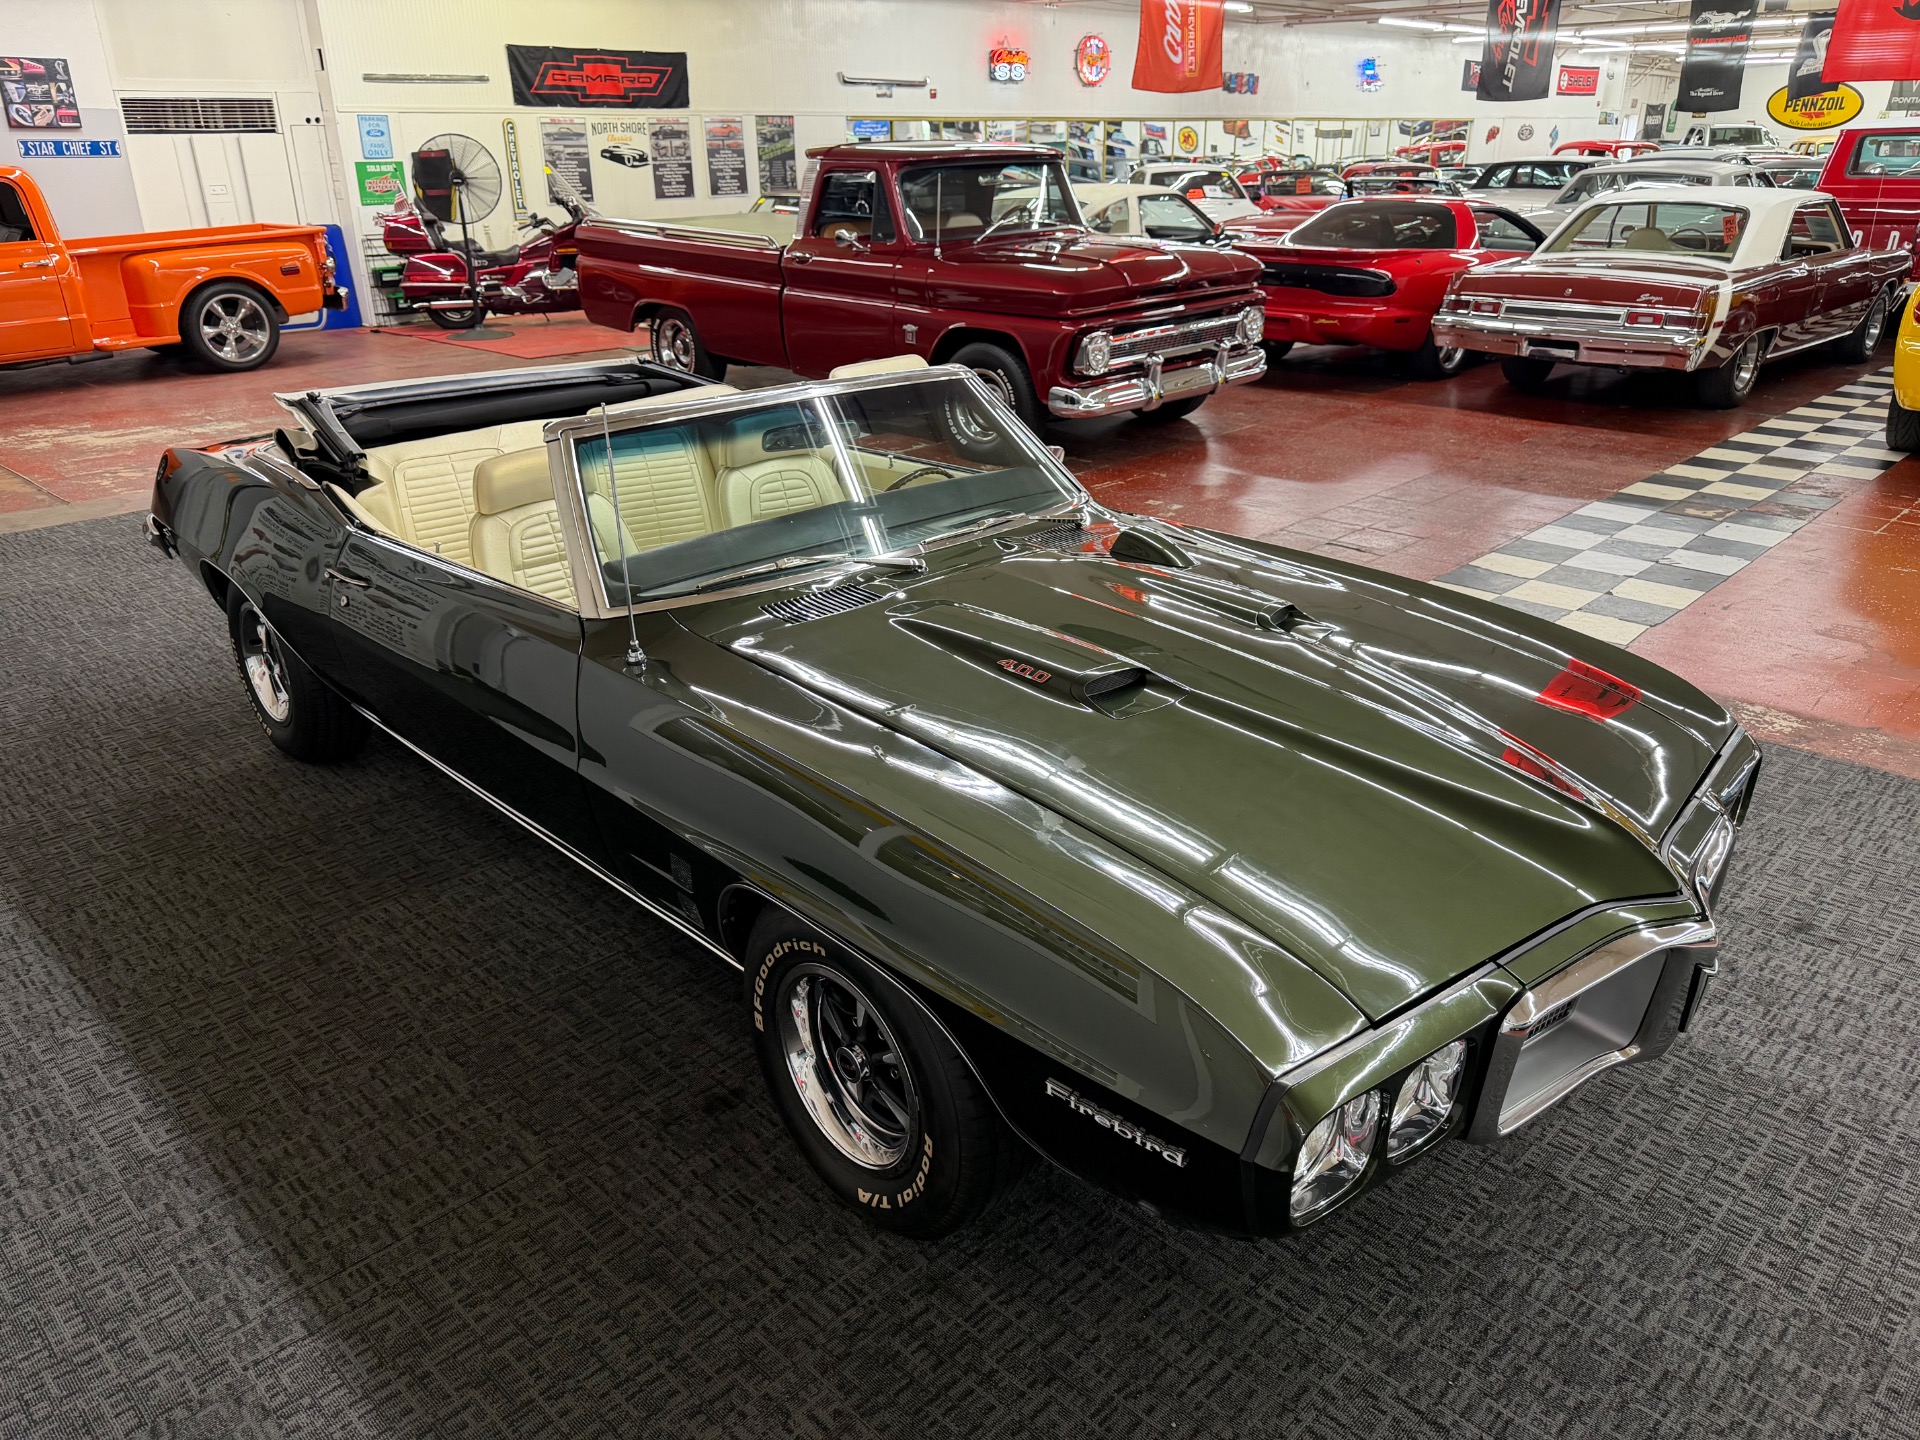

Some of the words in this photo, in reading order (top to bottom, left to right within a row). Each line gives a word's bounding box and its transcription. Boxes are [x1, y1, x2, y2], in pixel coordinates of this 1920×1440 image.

[1690, 34, 1748, 45] MUSTANG
[551, 73, 653, 85] CAMARO
[994, 62, 1025, 81] SS
[1567, 75, 1596, 88] SHELBY
[1783, 96, 1846, 113] PENNZOIL
[591, 122, 619, 136] NORTH
[620, 122, 648, 136] SHORE
[1800, 119, 1832, 127] Lubrication
[27, 141, 57, 156] STAR
[62, 141, 92, 156] CHIEF
[99, 141, 113, 156] ST
[368, 149, 389, 157] ONLY
[507, 123, 524, 208] CHEVROLET
[997, 658, 1052, 683] 400
[754, 938, 826, 1032] BFGoodrich
[1044, 1078, 1188, 1168] Firebird
[898, 1133, 933, 1208] Radial
[857, 1187, 892, 1210] T/A
